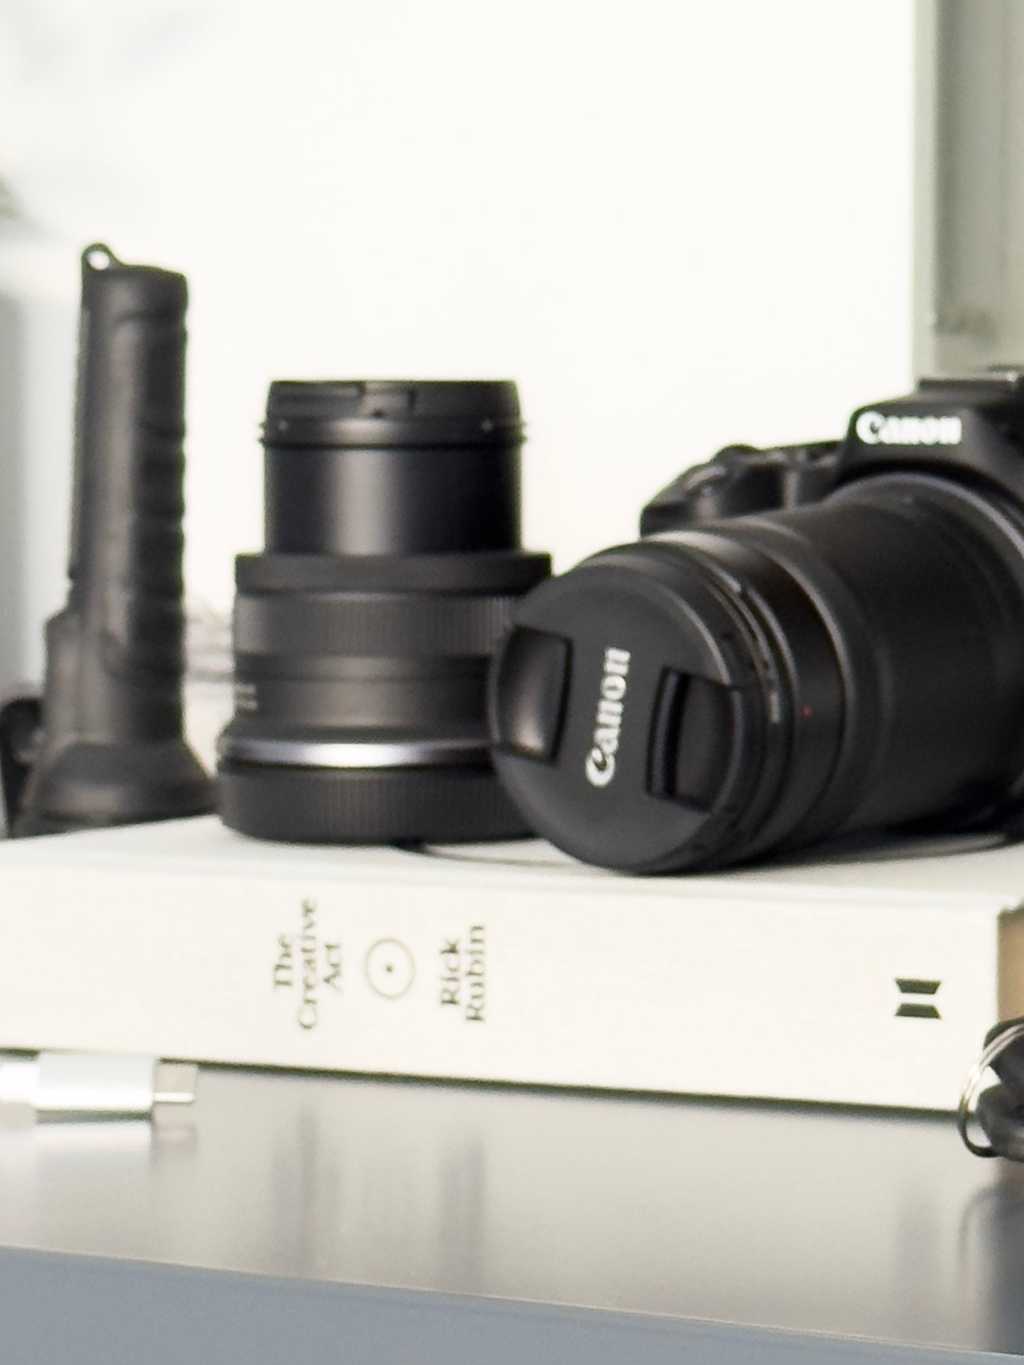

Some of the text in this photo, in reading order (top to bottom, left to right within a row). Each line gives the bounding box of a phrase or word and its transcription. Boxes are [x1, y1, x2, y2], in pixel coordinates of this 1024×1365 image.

[856, 410, 962, 445] Canon
[585, 647, 631, 787] Canon
[273, 934, 293, 990] The
[299, 898, 317, 1030] Creative
[323, 943, 343, 990] Act
[440, 939, 460, 1007] Rick
[465, 924, 486, 1022] Rubin
